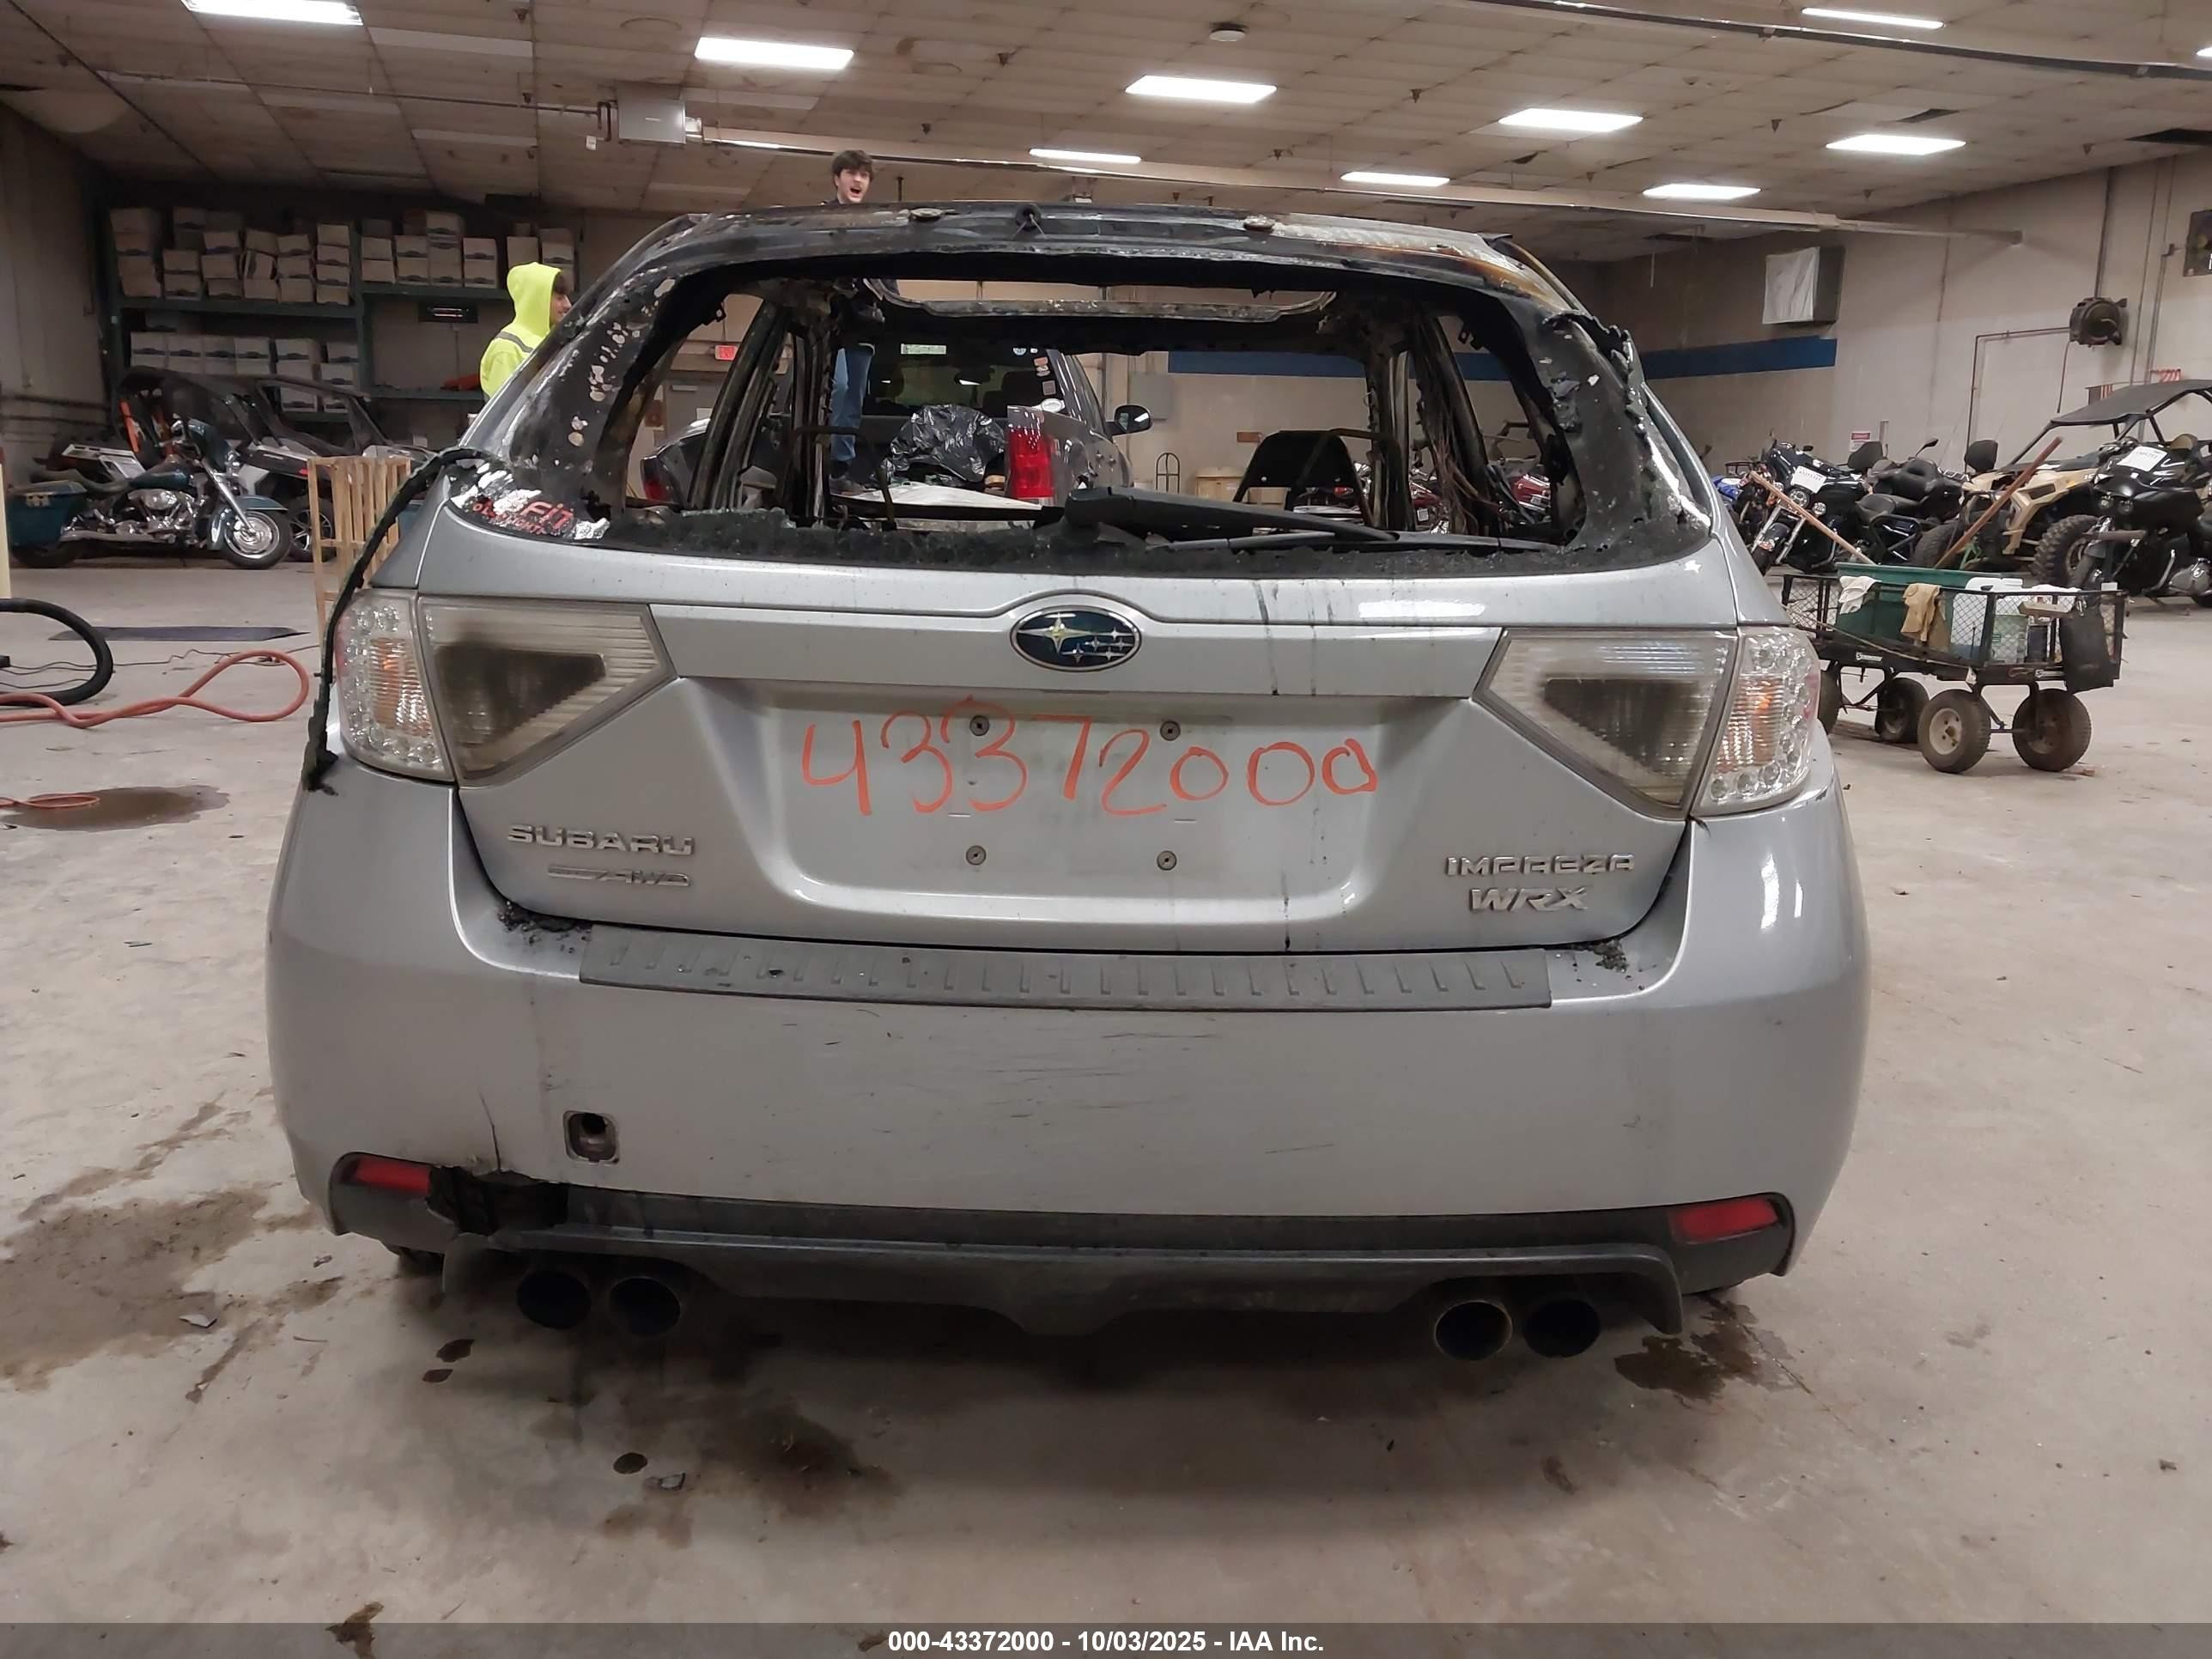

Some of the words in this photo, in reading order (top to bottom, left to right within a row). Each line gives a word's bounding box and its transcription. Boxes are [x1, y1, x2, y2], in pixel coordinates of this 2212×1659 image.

[802, 695, 1379, 817] 43372000
[507, 823, 694, 856] SUBARU
[1446, 854, 1636, 877] IMPREZA
[1469, 886, 1589, 912] WRX
